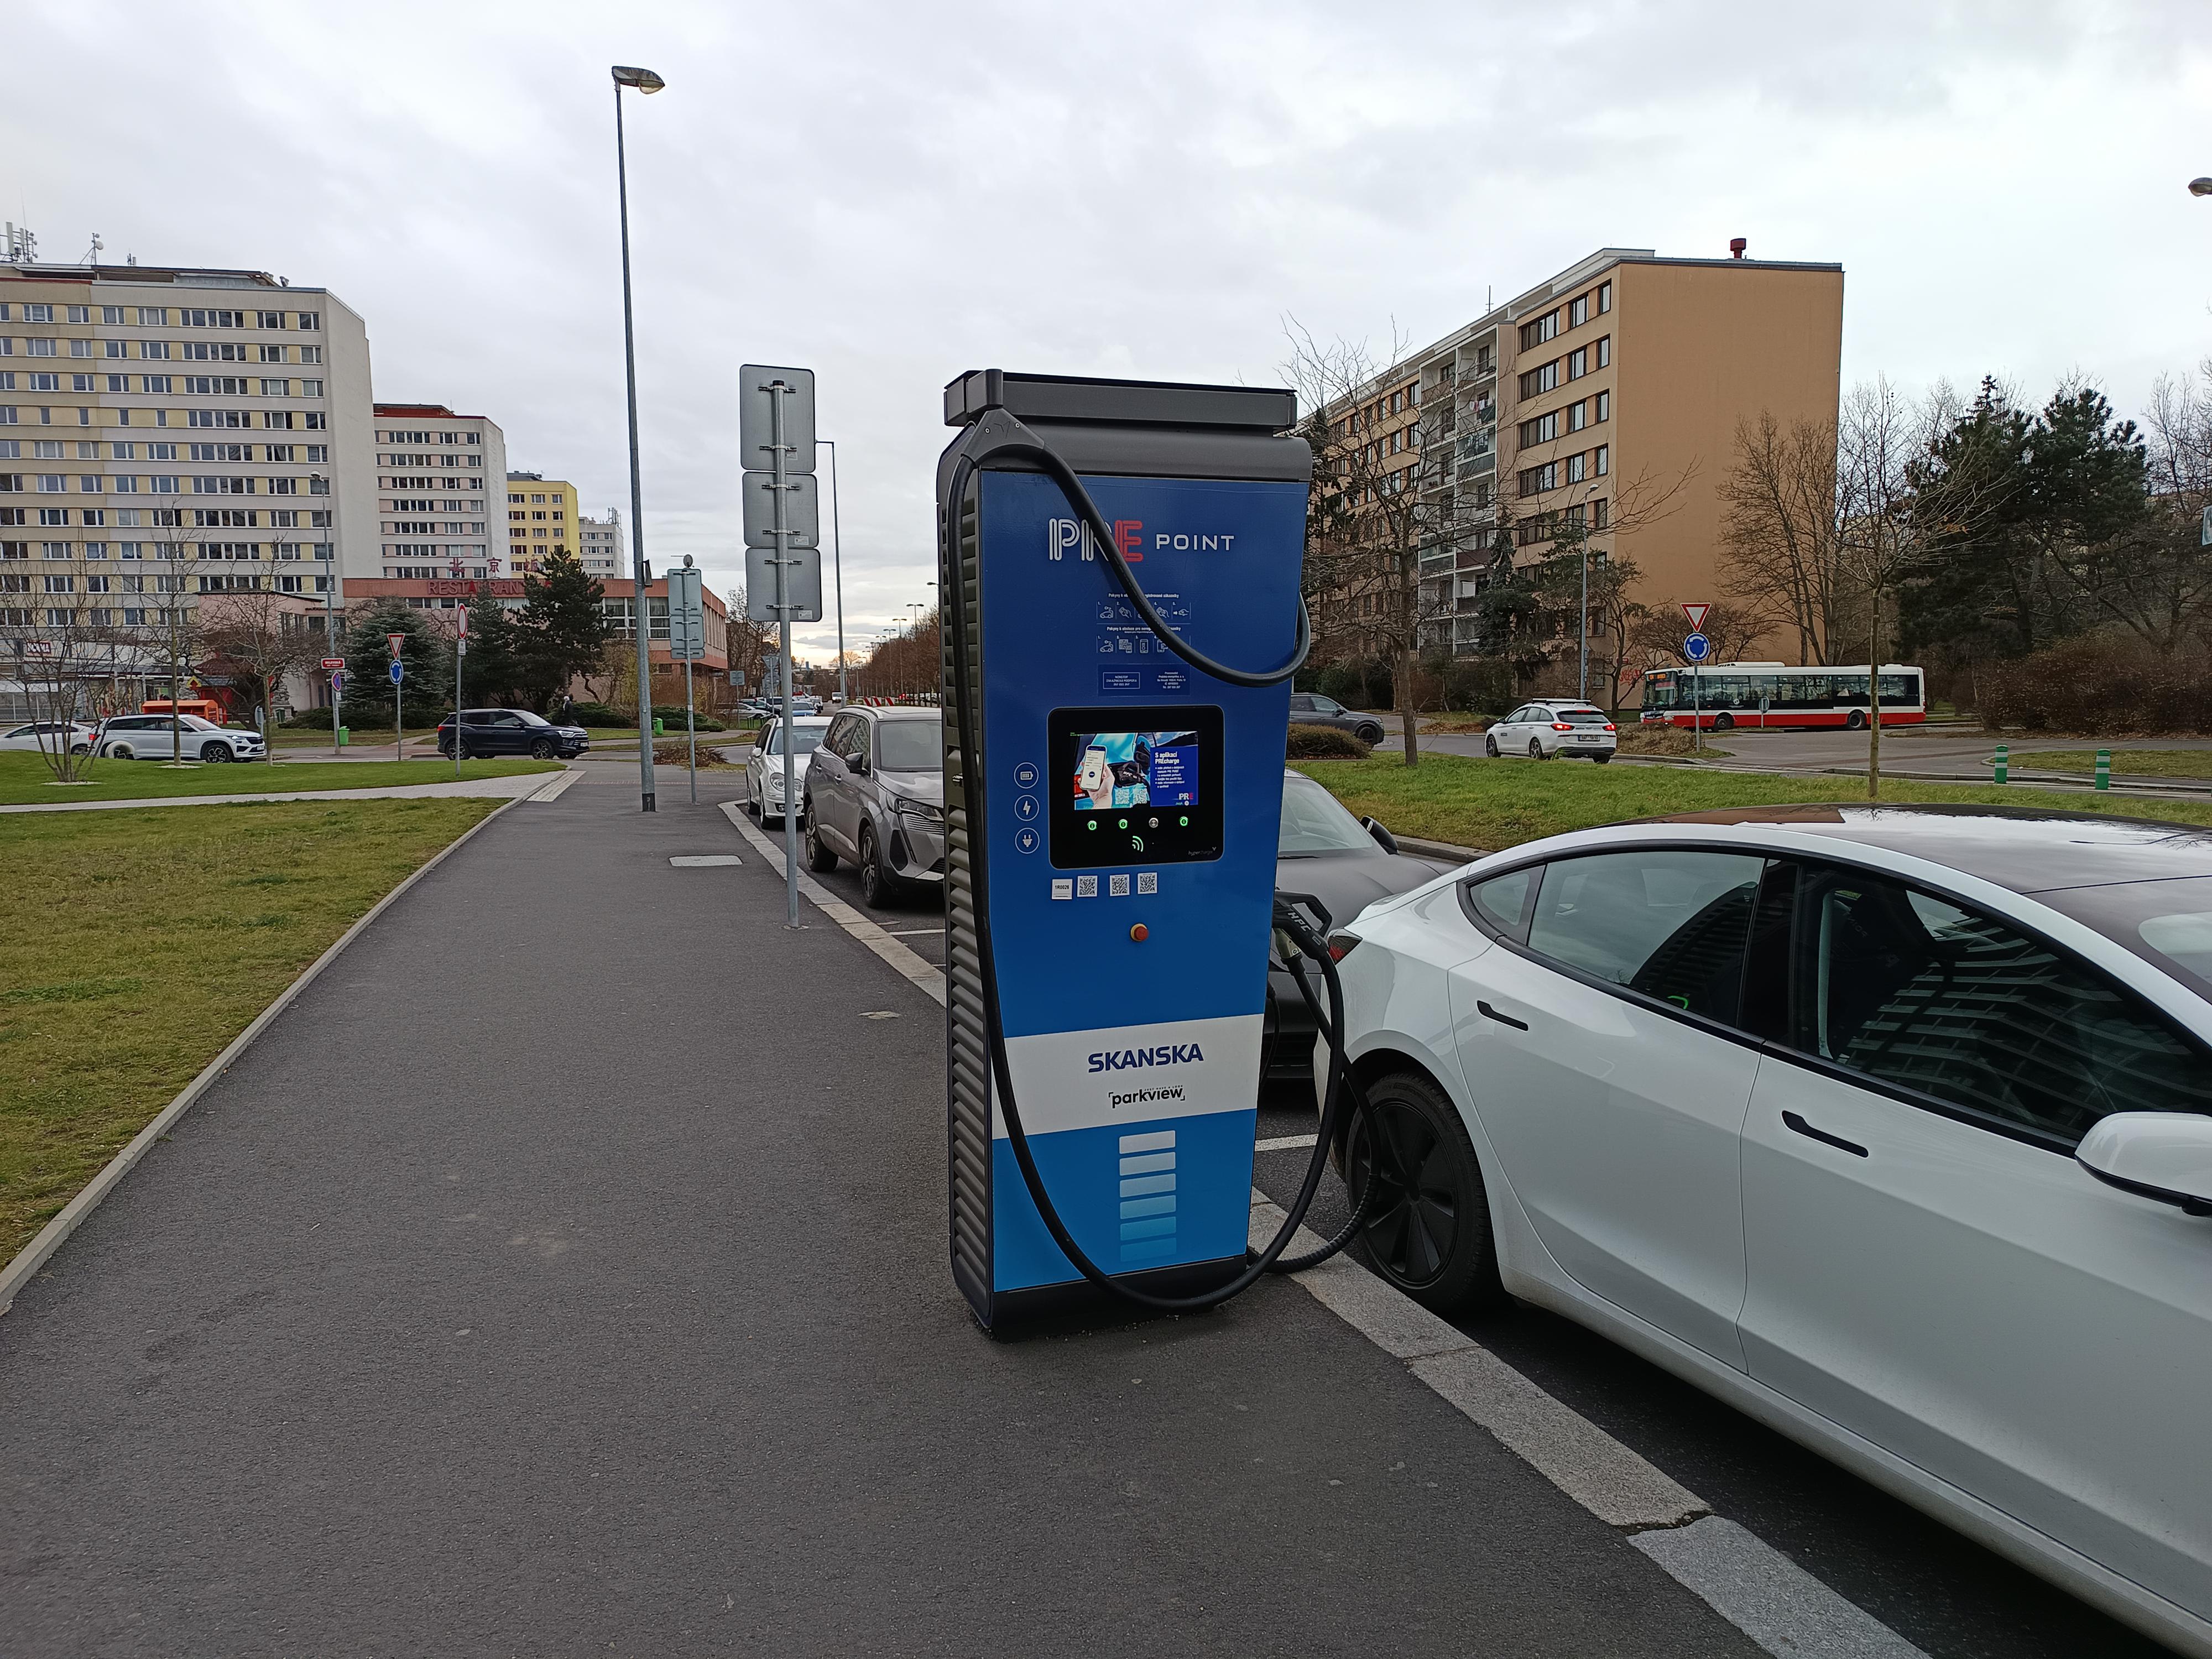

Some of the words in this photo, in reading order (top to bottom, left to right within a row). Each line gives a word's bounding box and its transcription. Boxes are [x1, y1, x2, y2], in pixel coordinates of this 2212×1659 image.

[1156, 534, 1234, 551] POINT
[428, 581, 525, 594] RESTARAN
[1287, 912, 1311, 931] HPC
[1088, 1044, 1204, 1073] SKANSKA
[1112, 1088, 1183, 1109] parkview
